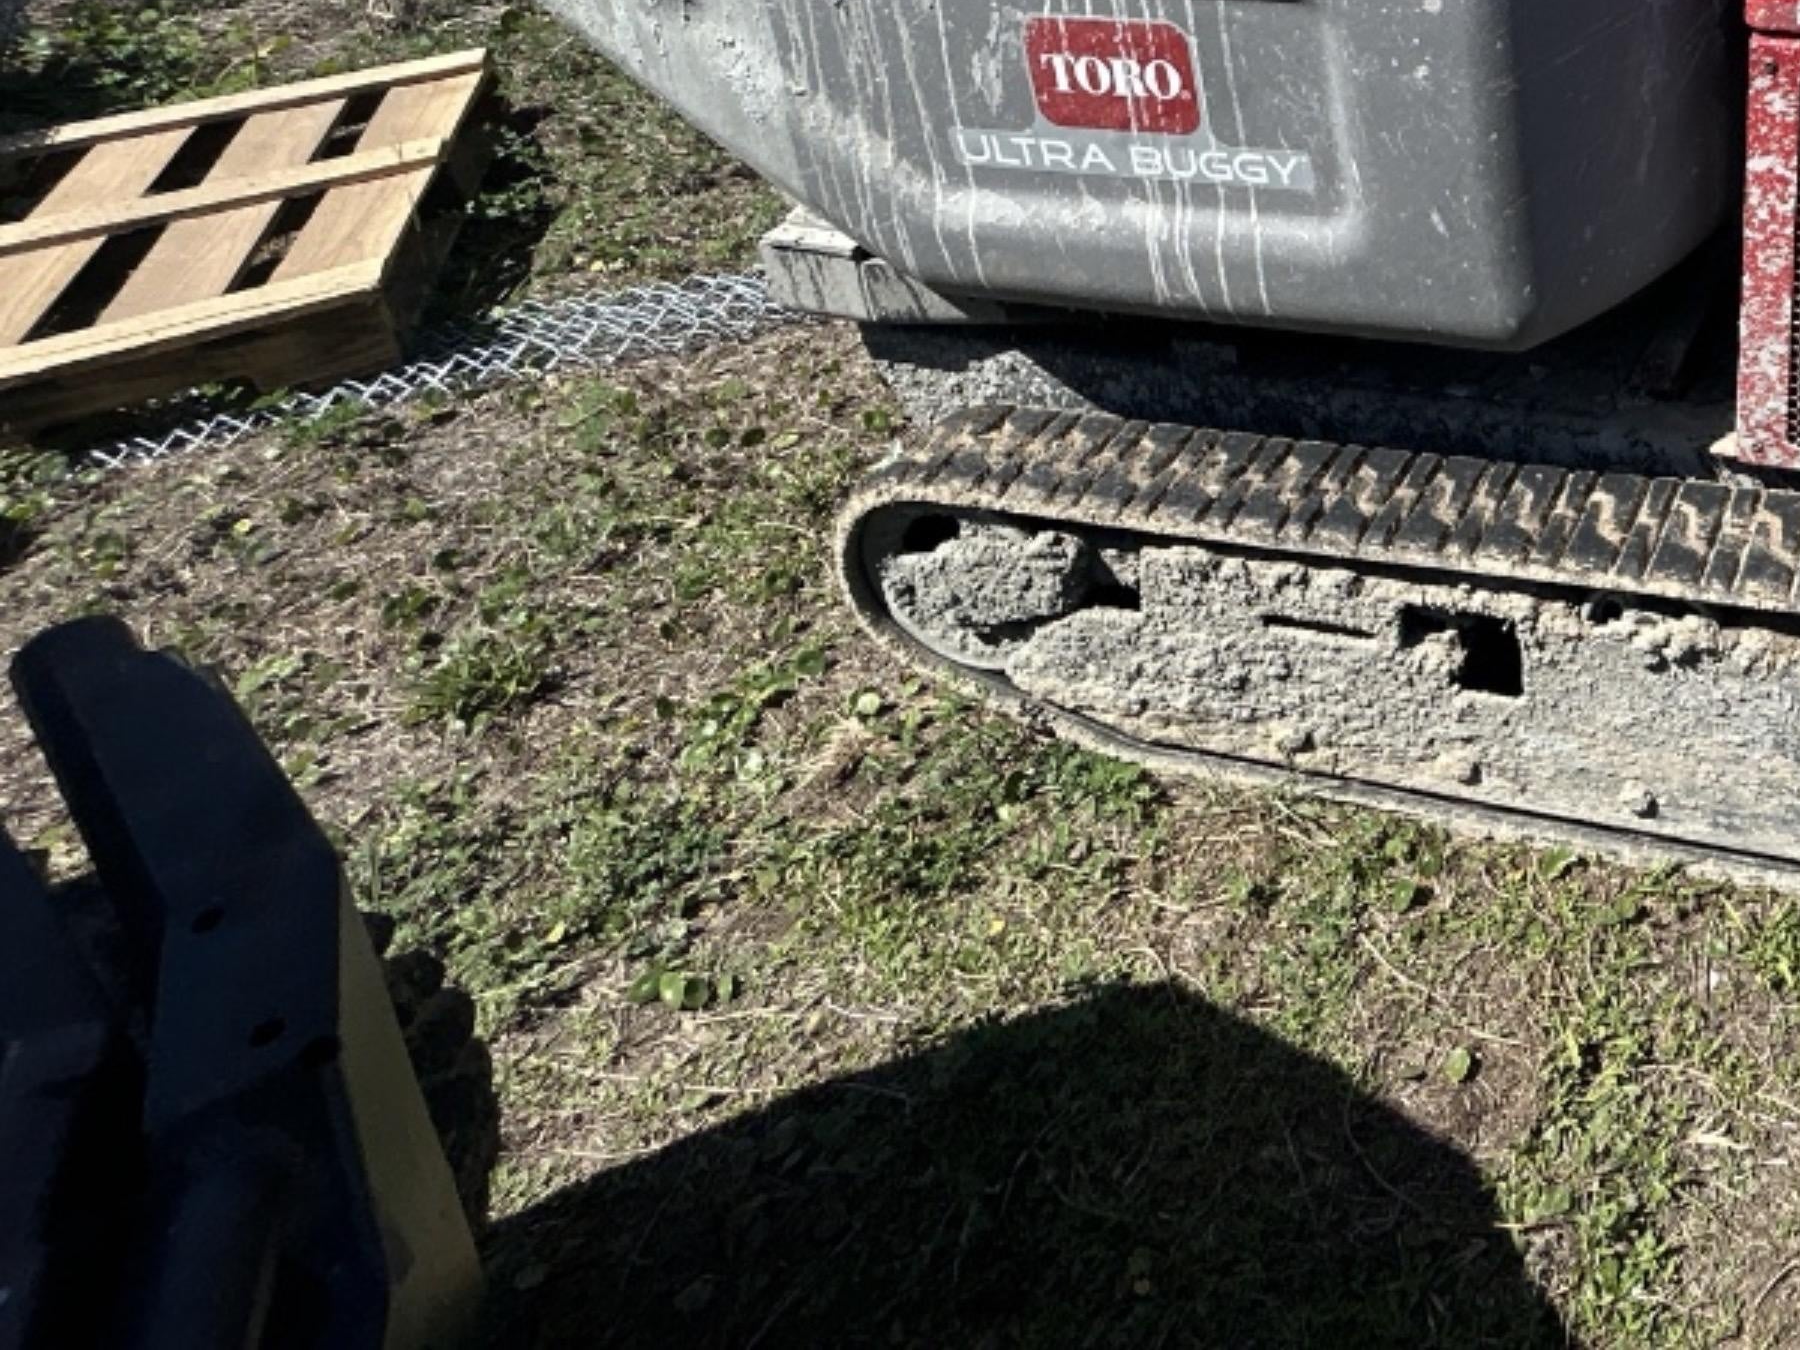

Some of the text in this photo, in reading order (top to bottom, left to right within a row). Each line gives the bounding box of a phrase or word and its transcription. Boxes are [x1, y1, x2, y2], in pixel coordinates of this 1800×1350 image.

[1040, 53, 1182, 100] TORO
[957, 133, 1299, 186] ULTRA BUGGY
